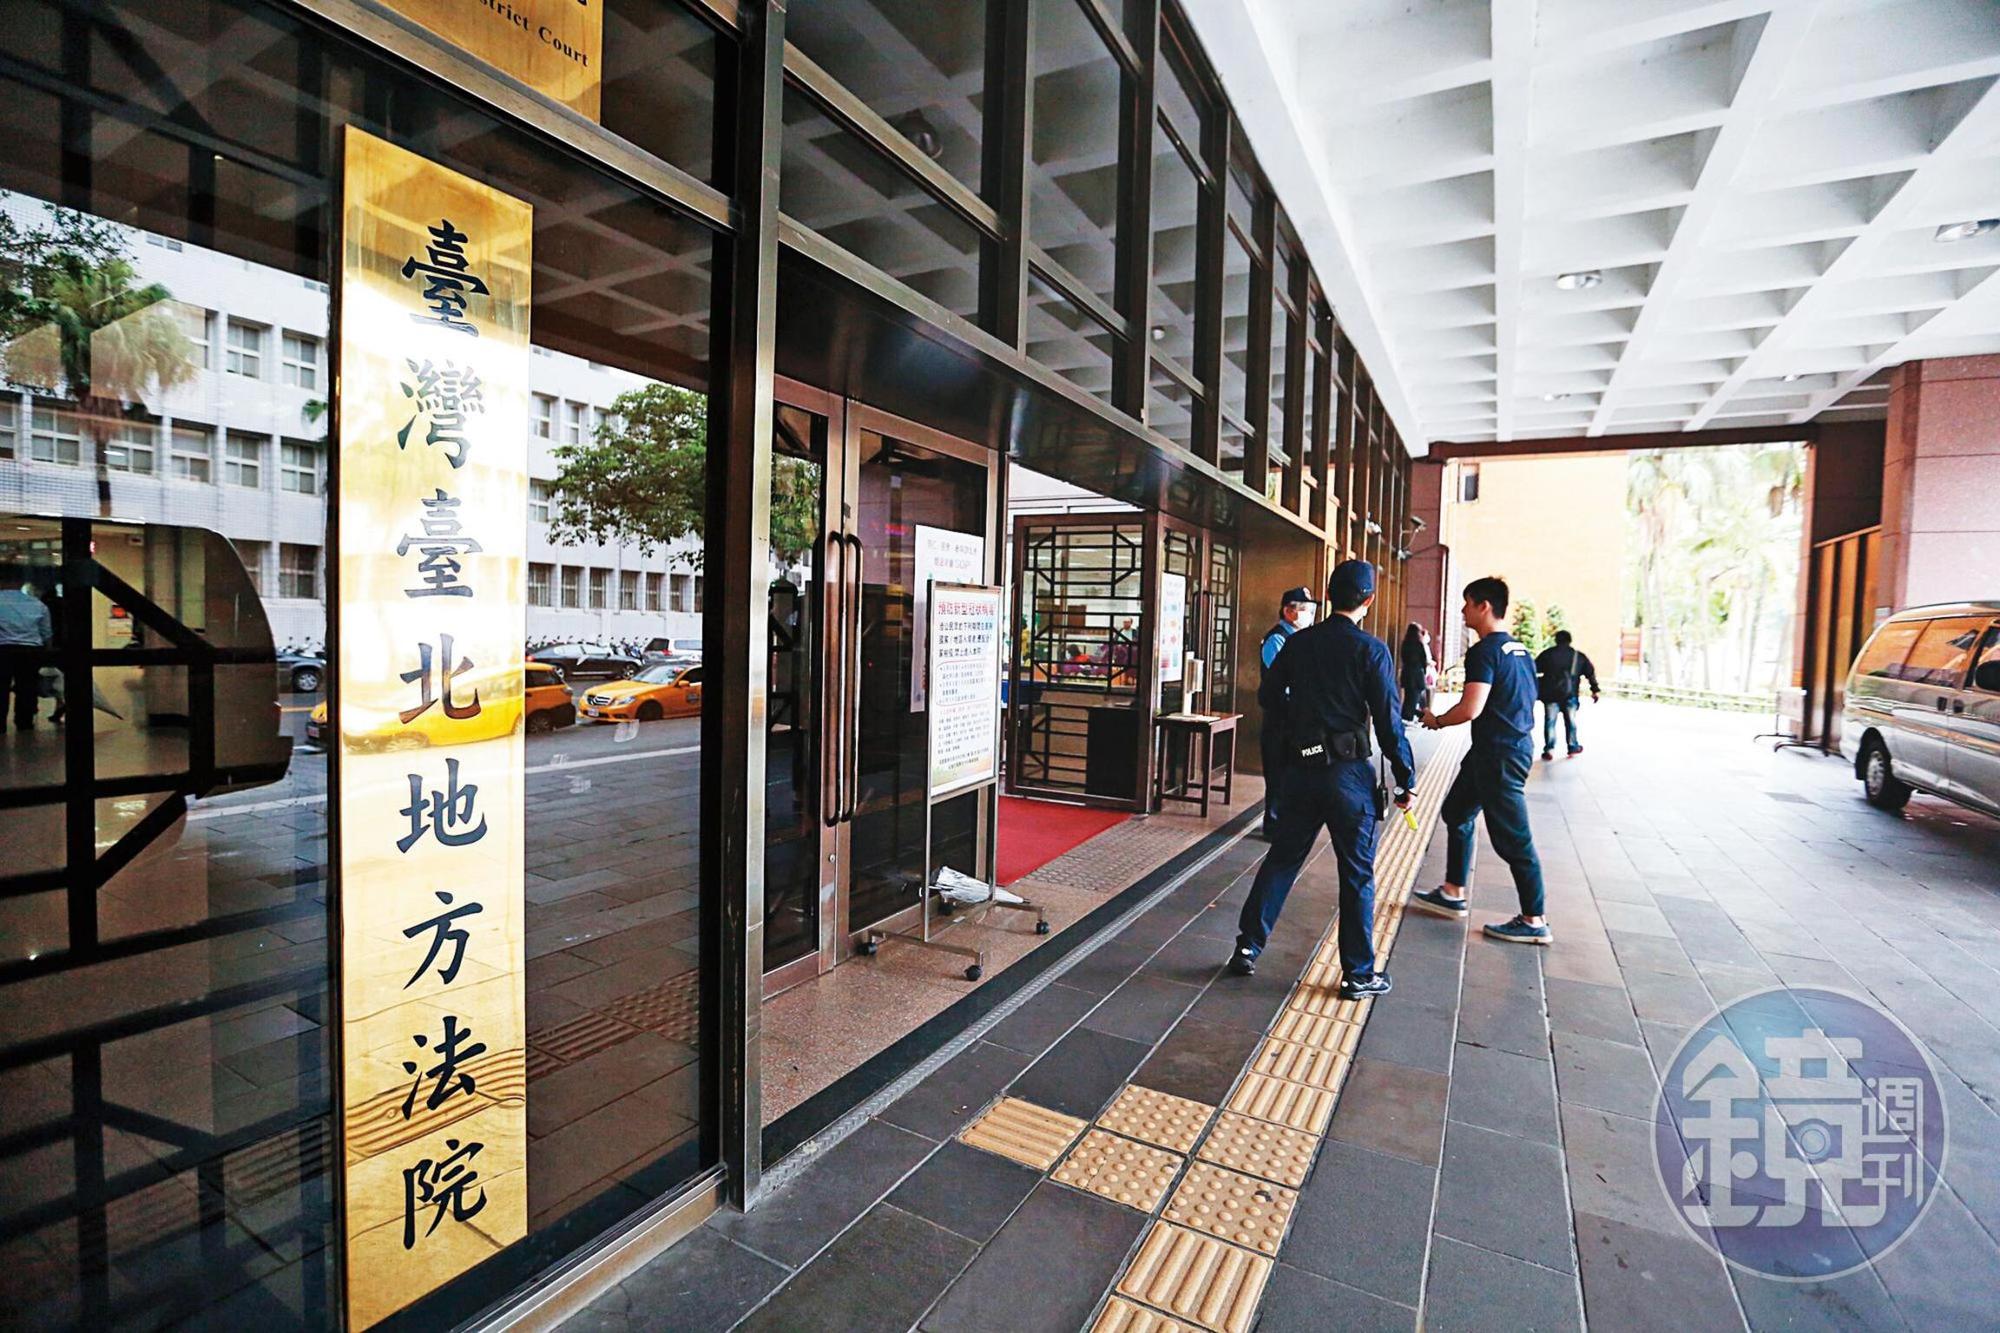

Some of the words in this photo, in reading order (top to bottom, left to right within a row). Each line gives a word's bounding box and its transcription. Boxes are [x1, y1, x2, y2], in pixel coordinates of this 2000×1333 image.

[538, 26, 588, 67] Court
[396, 218, 490, 1250] 臺灣臺北地方法院
[1301, 744, 1324, 757] POLICE
